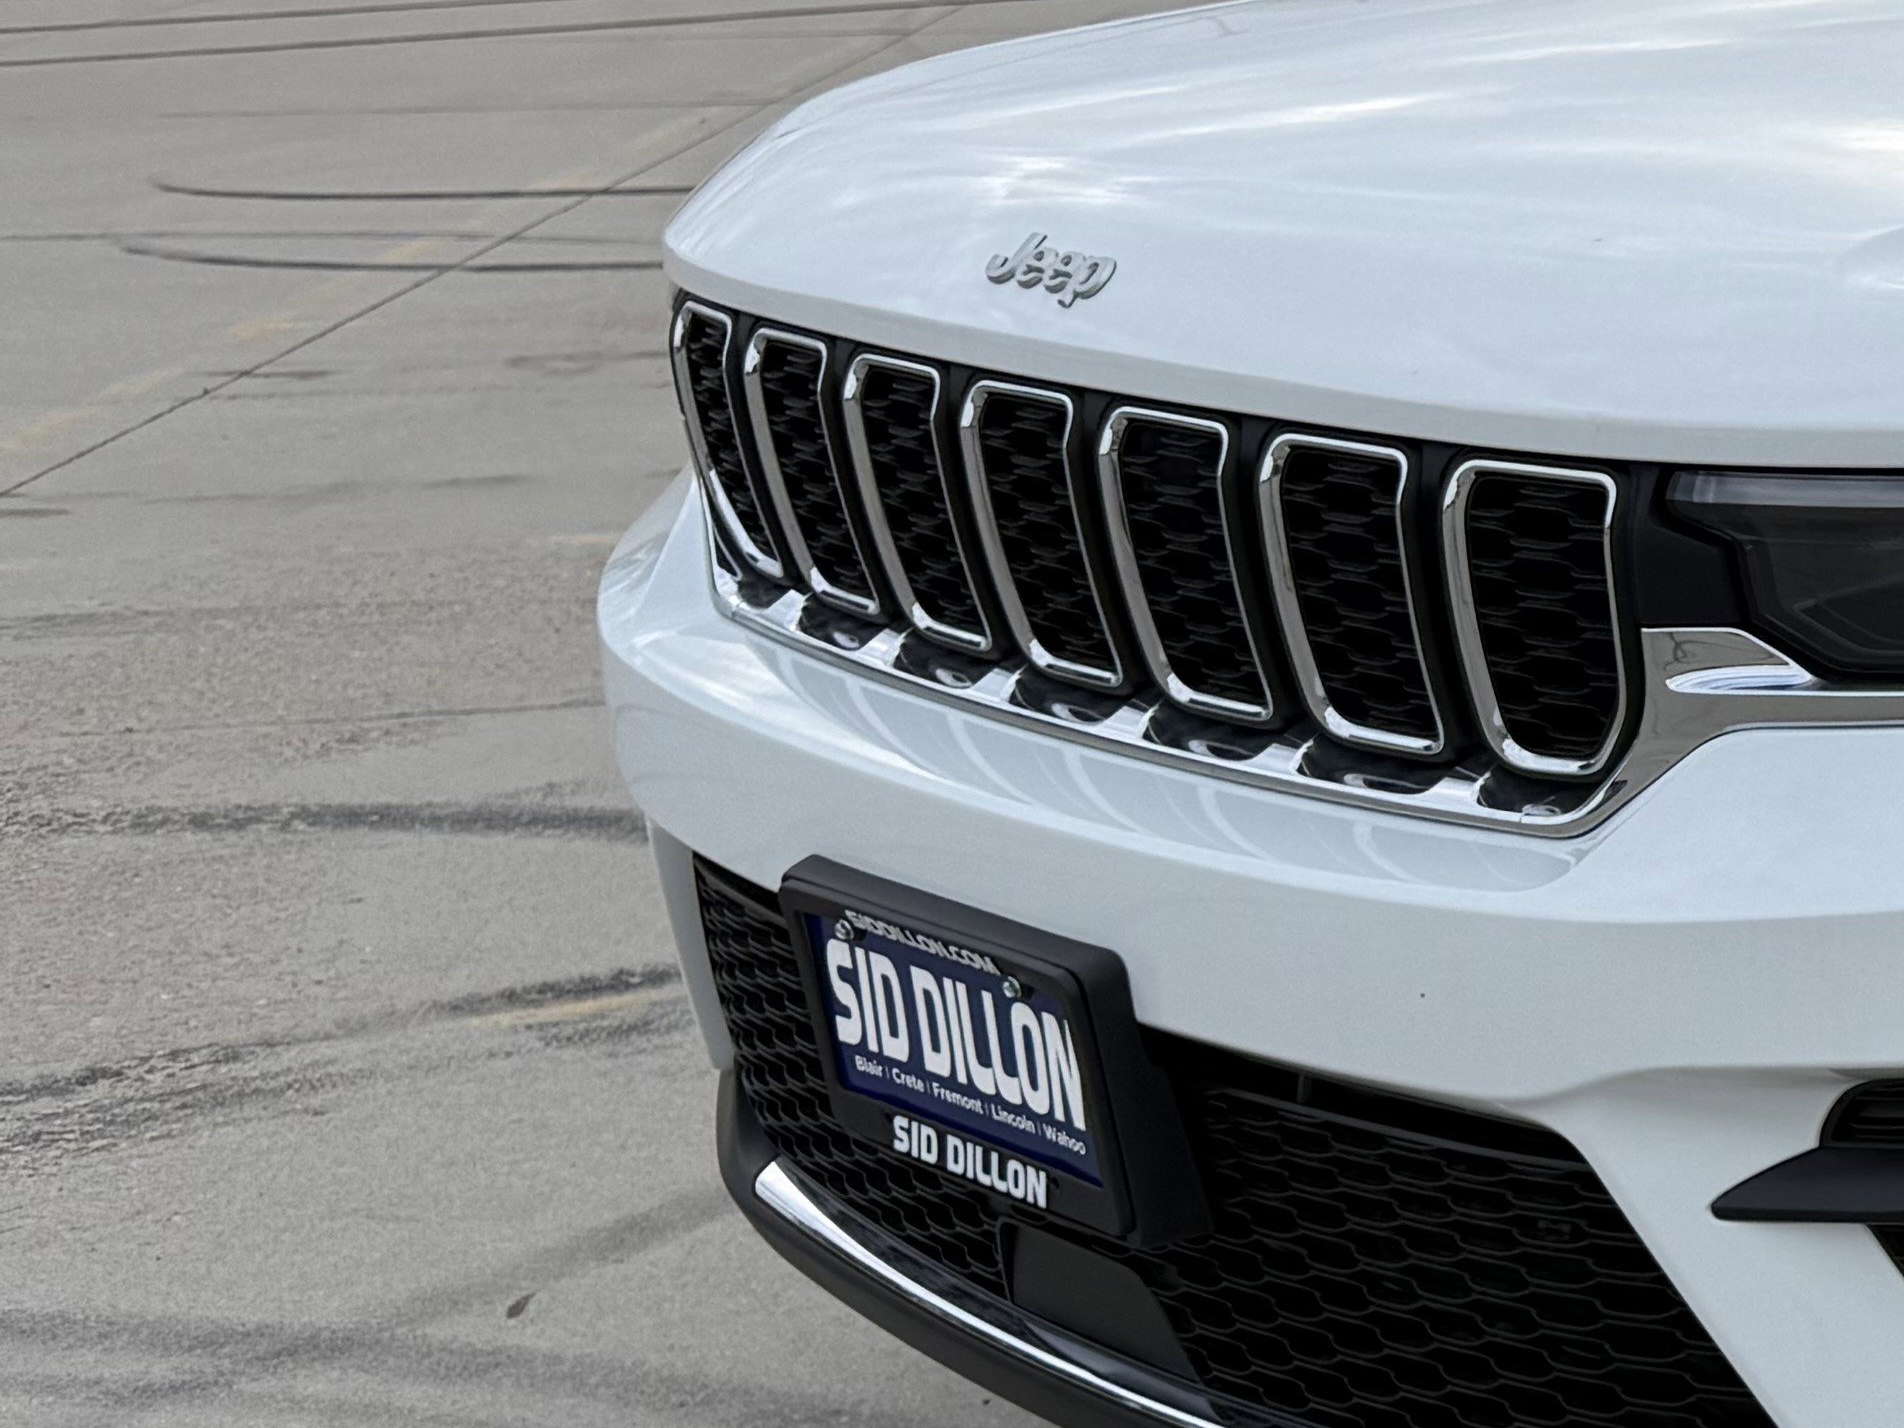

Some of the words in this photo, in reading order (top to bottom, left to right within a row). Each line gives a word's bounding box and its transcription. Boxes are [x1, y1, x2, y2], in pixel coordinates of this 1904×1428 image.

[985, 232, 1117, 309] Jeep
[826, 938, 909, 1063] SID
[910, 965, 1087, 1131] DILLON
[855, 1055, 883, 1077] Blair
[892, 1068, 924, 1093] Crete
[932, 1082, 984, 1115] Fremont
[991, 1104, 1036, 1134] Lincoln
[1042, 1122, 1087, 1155] Wahoo
[893, 1115, 938, 1164] SID
[946, 1134, 1047, 1209] DILLON
